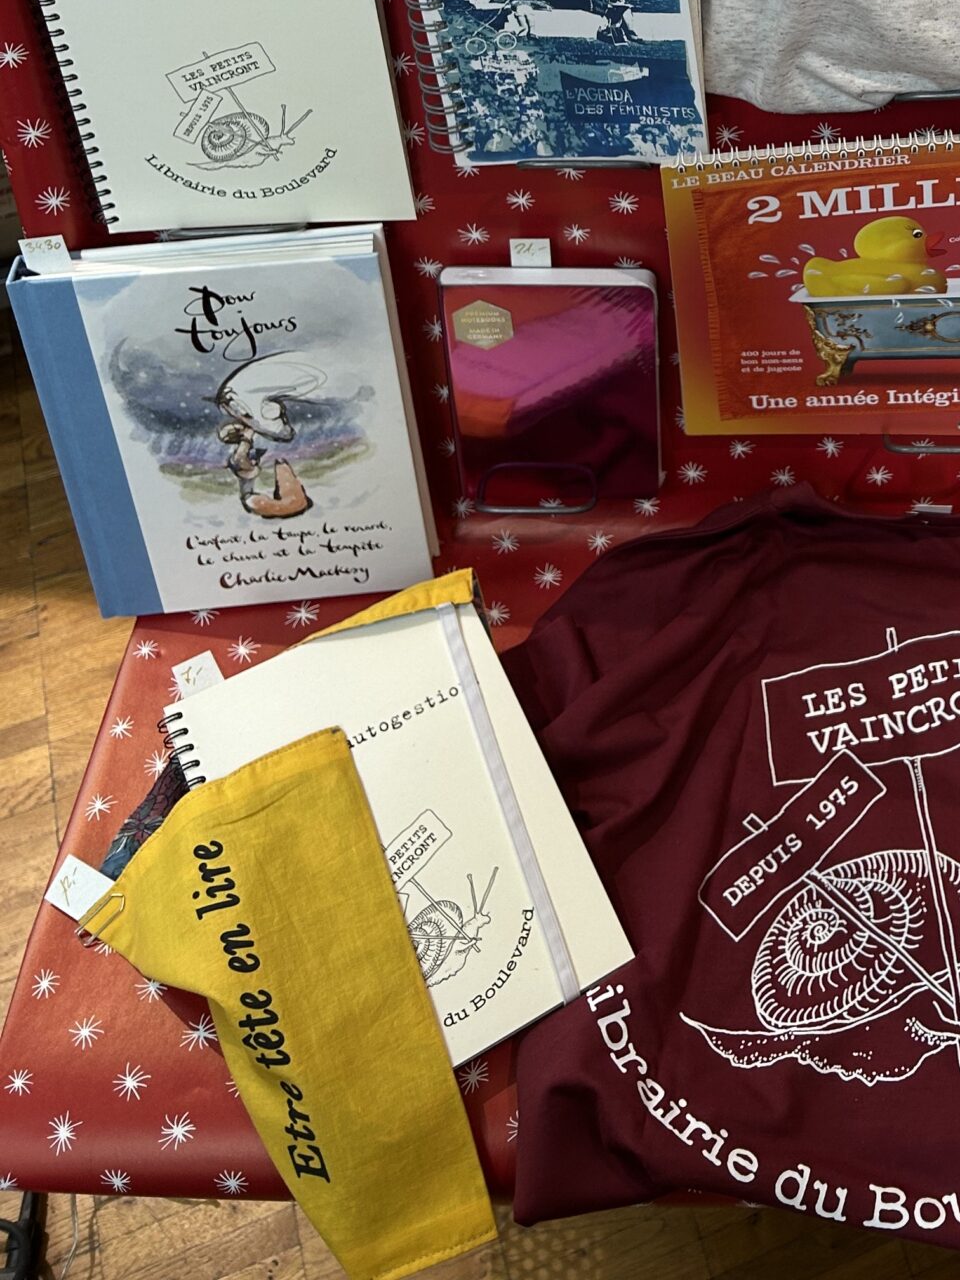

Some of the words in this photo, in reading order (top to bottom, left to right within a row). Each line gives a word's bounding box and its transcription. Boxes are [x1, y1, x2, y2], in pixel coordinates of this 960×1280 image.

[182, 69, 205, 82] LES
[209, 51, 253, 72] PETITS
[188, 60, 260, 92] VAINCRONT
[566, 87, 633, 103] L'AGENDA
[574, 103, 603, 115] DES
[610, 101, 696, 120] FÉMINISTES
[639, 116, 671, 126] 2026
[144, 154, 227, 198] Librairie
[232, 189, 258, 199] du
[260, 148, 337, 198] Boulevard
[671, 176, 700, 190] LE
[706, 168, 765, 186] BEAU
[770, 154, 911, 177] CALENDRIER
[747, 195, 783, 224] 2
[174, 310, 297, 362] toujours
[748, 394, 798, 410] Une
[805, 390, 879, 407] année
[220, 569, 288, 589] Charlie
[288, 565, 370, 584] Mackesy
[801, 682, 867, 718] LES
[389, 824, 428, 865] PETITS
[722, 833, 803, 907] DEPUIS
[806, 775, 859, 830] 1975
[192, 840, 241, 920] lire
[219, 923, 261, 974] en
[443, 1007, 470, 1028] du
[469, 906, 536, 1012] Boulevard
[238, 989, 291, 1069] tête
[586, 984, 759, 1183] ibrairie
[774, 1163, 848, 1222] du
[280, 1079, 331, 1184] Etre
